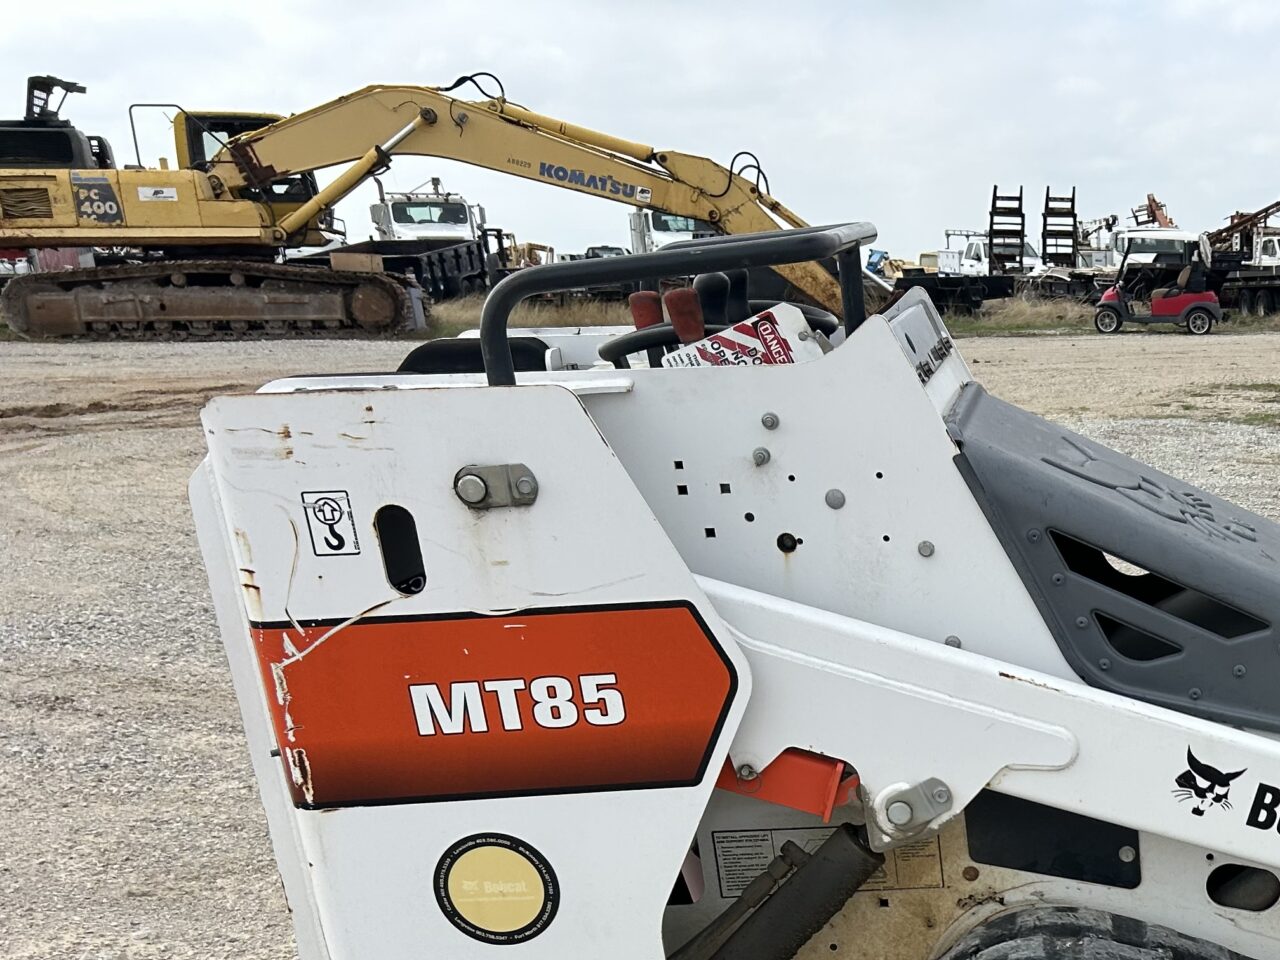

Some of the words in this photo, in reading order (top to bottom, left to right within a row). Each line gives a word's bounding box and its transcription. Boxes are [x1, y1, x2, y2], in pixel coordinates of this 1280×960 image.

[539, 162, 636, 198] KOMATSU
[79, 189, 100, 200] PC
[81, 201, 118, 215] 400
[408, 672, 627, 737] MT85
